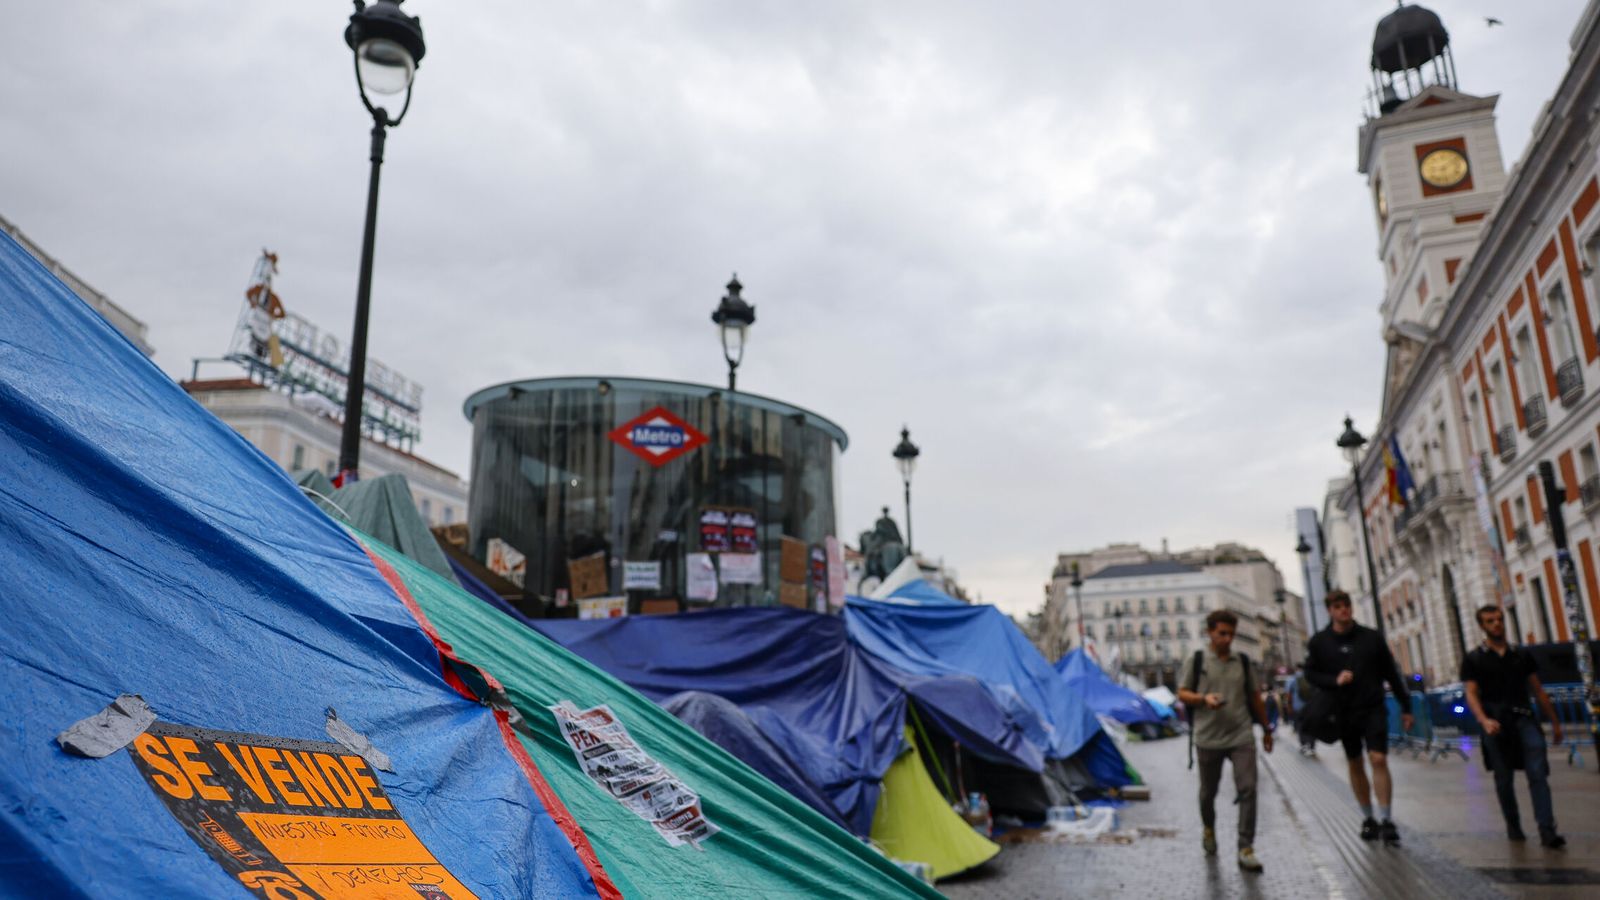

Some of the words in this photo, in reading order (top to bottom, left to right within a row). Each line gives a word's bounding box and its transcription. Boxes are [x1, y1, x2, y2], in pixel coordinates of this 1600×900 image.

[634, 428, 681, 445] Metro
[133, 732, 233, 801] SE
[214, 742, 393, 811] VENDE
[254, 819, 336, 840] NUESTRO
[341, 822, 406, 840] FUTURO
[309, 870, 333, 891] Y
[332, 865, 444, 889] DERECHOS
